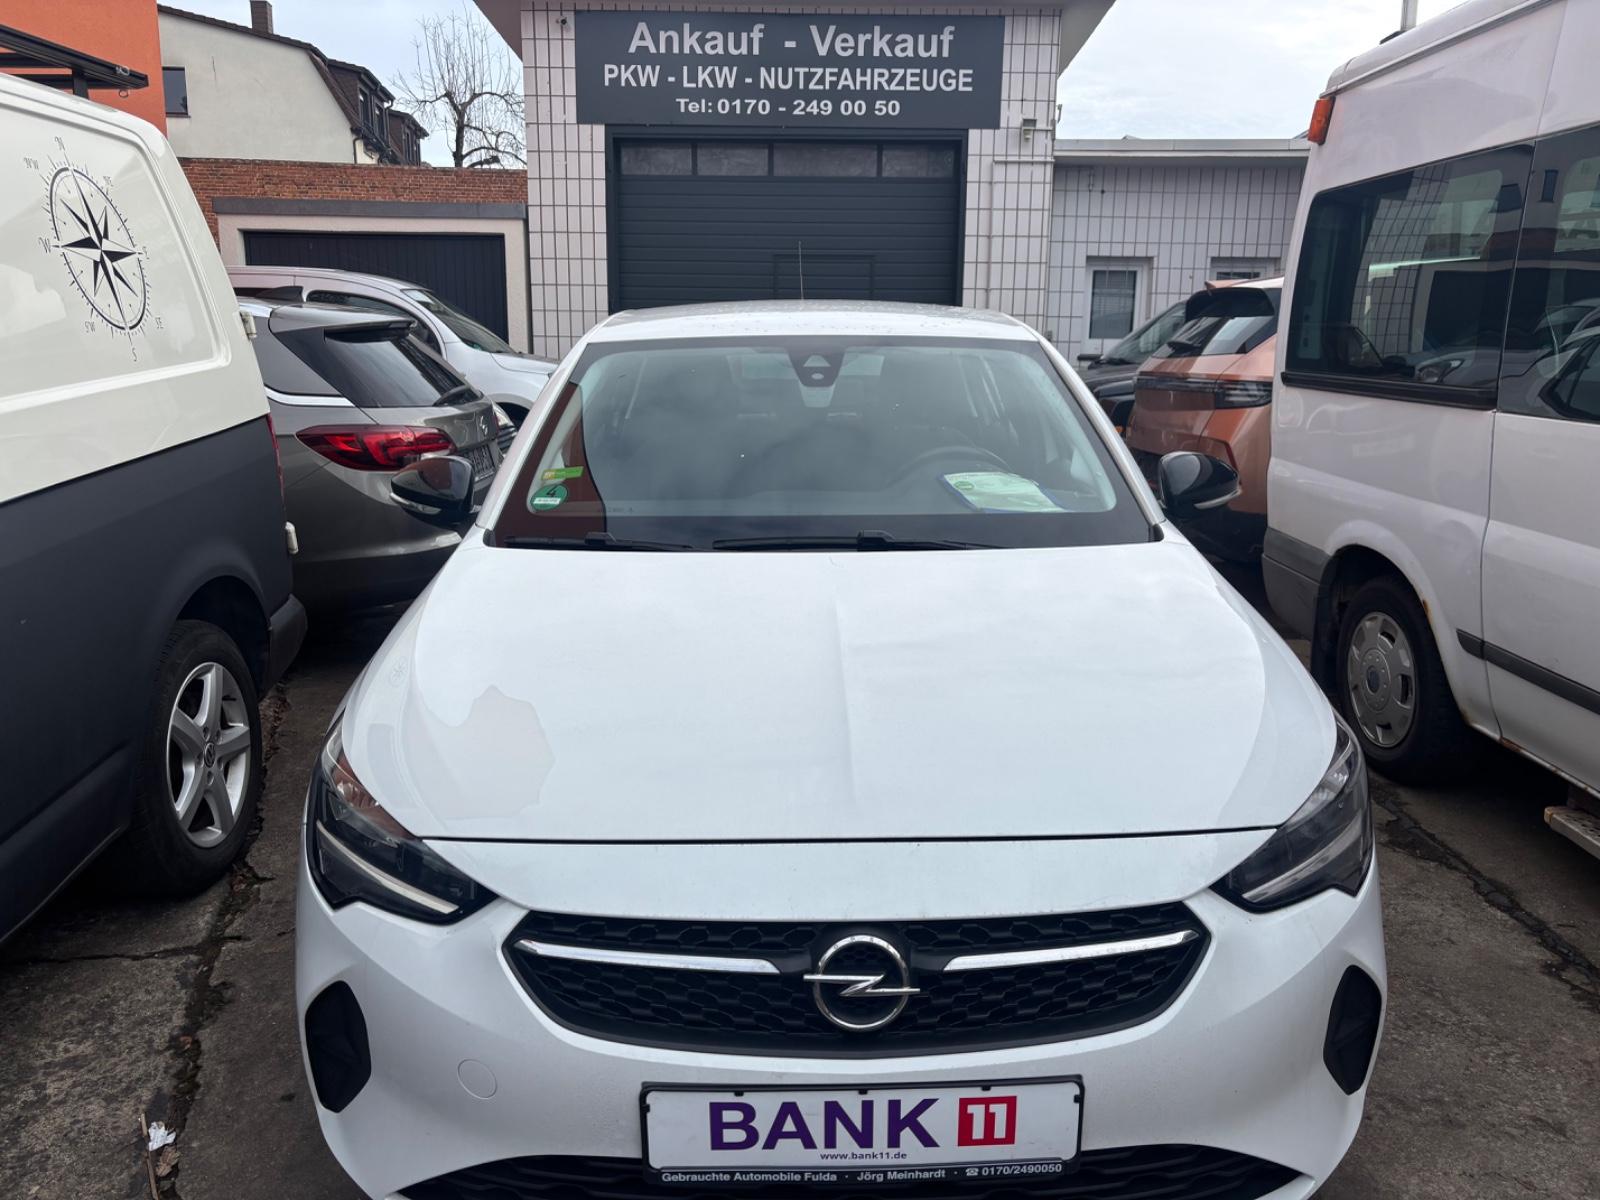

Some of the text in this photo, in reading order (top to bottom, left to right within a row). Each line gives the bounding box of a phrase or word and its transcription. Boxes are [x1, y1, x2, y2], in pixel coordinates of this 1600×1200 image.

[627, 21, 765, 55] Ankauf
[809, 25, 956, 58] Verkauf
[604, 63, 660, 87] PKW
[682, 65, 738, 88] LKW
[760, 66, 973, 91] NUTZFAHRZEUGE
[675, 98, 713, 113] Tel:
[717, 98, 771, 115] 0170
[792, 99, 833, 115] 249
[840, 99, 867, 116] 00
[874, 100, 900, 116] 50
[709, 1098, 1007, 1150] BANK 11
[820, 1151, 907, 1160] www.bank11.de
[662, 1164, 1062, 1182] Gebrauchte Automobile Fulda Jörg Meinhardt 0170/2490050
